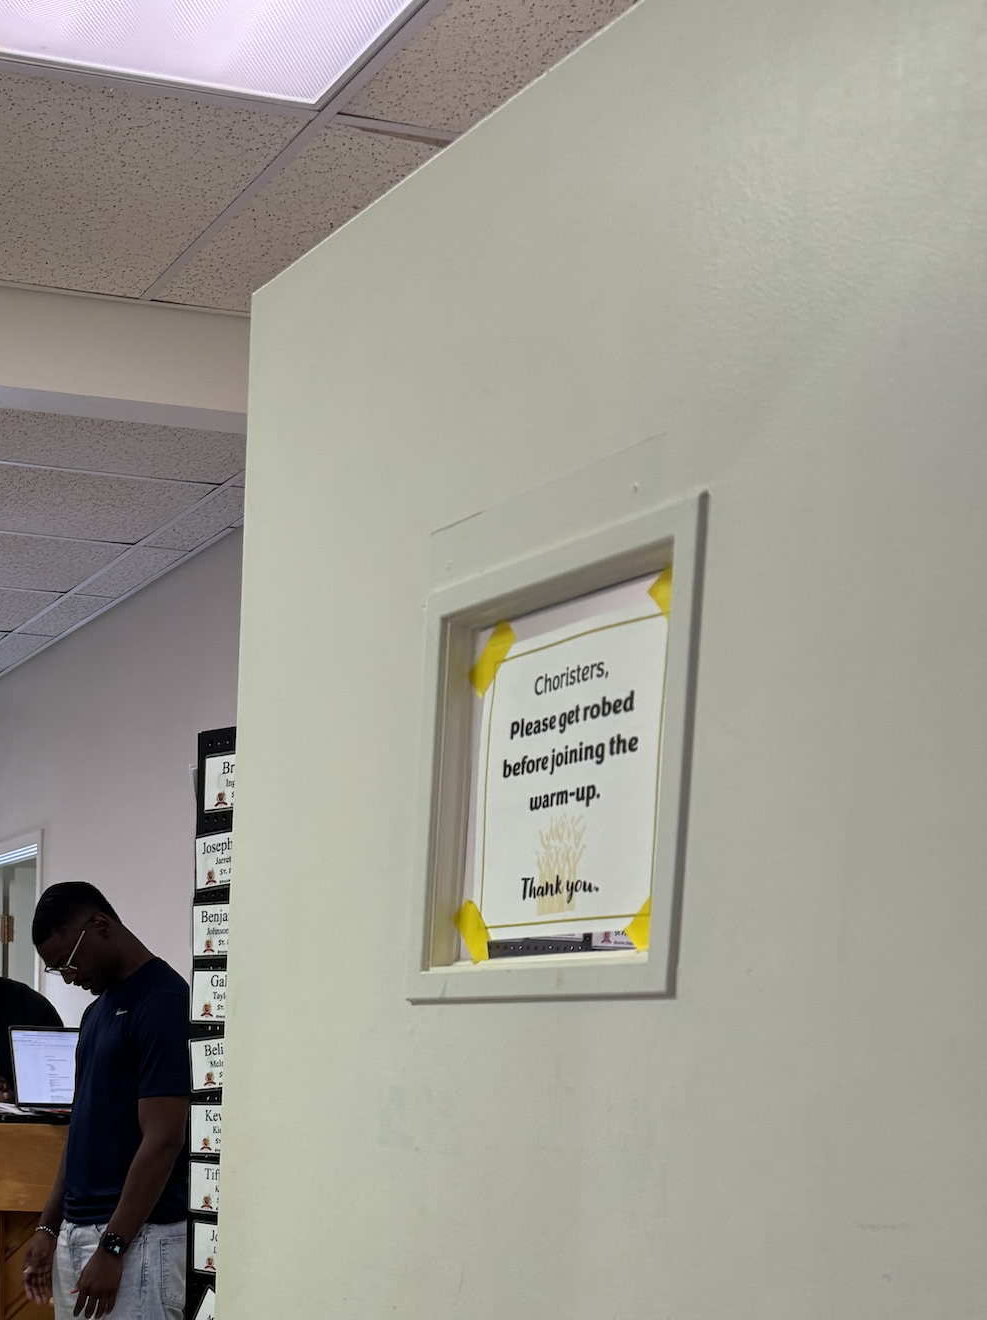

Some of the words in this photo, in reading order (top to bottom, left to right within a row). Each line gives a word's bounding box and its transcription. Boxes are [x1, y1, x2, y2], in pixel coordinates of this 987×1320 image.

[534, 660, 610, 696] Choristers,
[510, 714, 556, 740] Please
[558, 706, 580, 733] get
[583, 690, 635, 721] robed
[502, 755, 549, 778] before
[550, 740, 604, 775] joining
[609, 734, 639, 755] the
[529, 784, 601, 812] warm-up.
[202, 837, 232, 854] Joseph
[521, 875, 562, 901] Thank
[565, 880, 600, 904] you.
[201, 909, 229, 925] Benja
[212, 992, 226, 1001] Tayl
[204, 1043, 223, 1056] Beli
